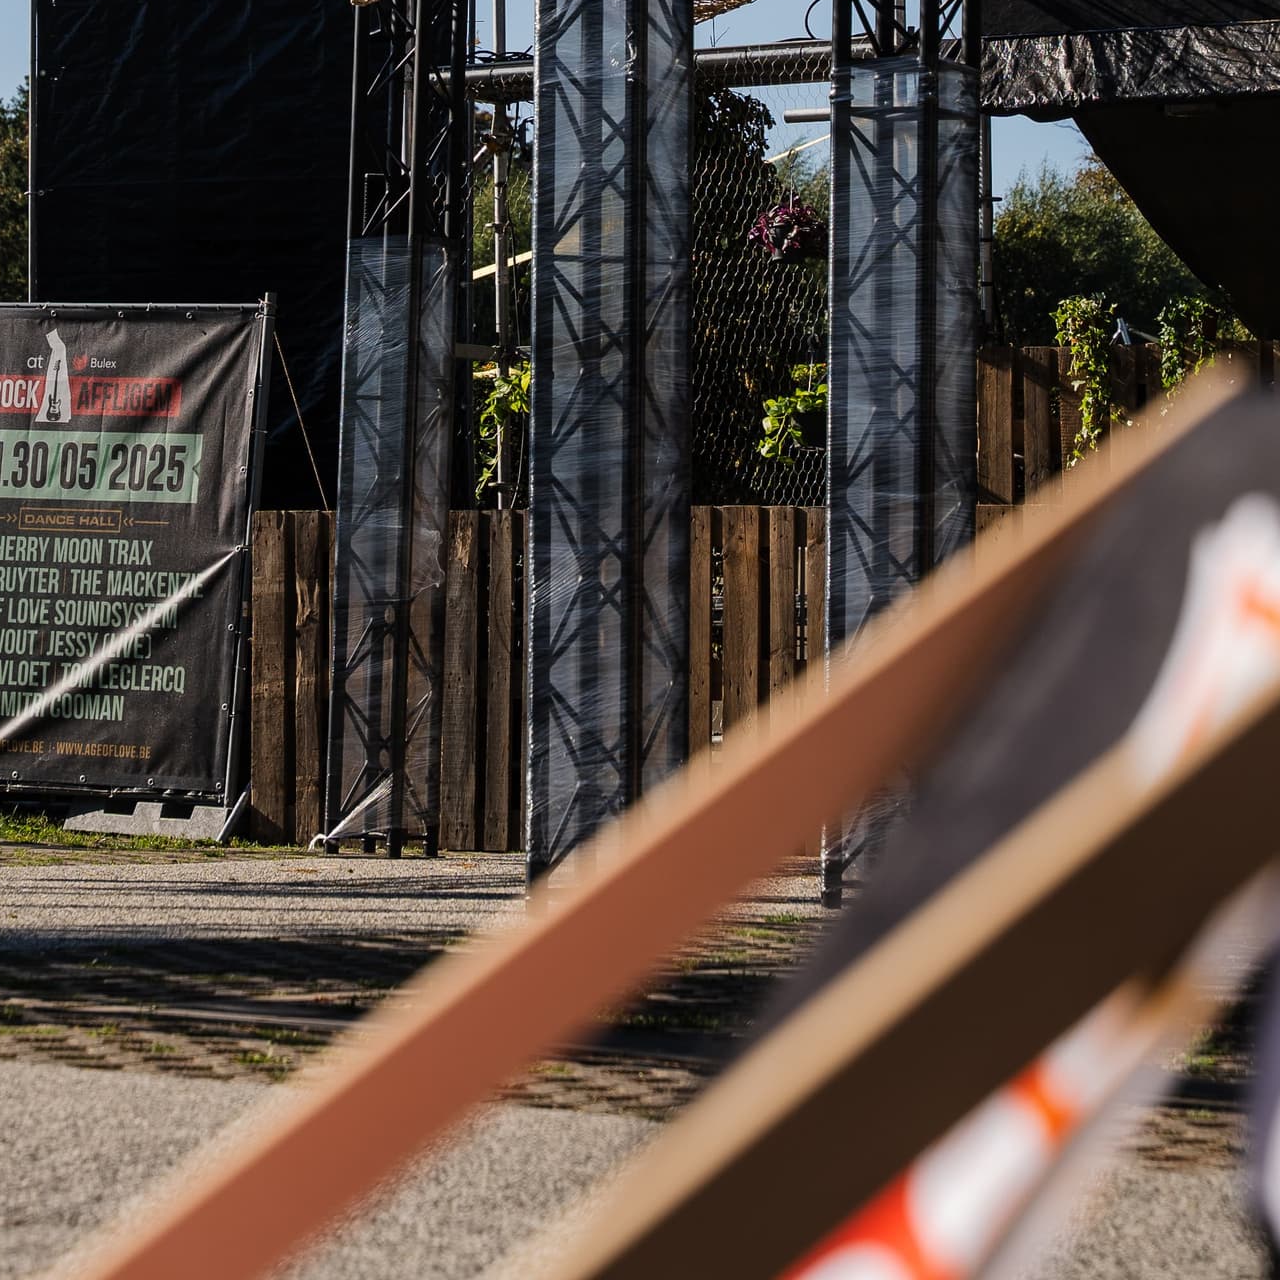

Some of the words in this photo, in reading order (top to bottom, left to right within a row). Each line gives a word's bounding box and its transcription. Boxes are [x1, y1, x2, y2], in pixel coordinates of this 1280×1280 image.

[26, 354, 44, 369] at
[90, 357, 117, 369] Bulex
[76, 382, 173, 412] AFFLIGEM
[24, 514, 75, 526] DANCE
[79, 516, 116, 527] HALL
[52, 537, 104, 565] MOON
[108, 539, 154, 566] TRAX
[70, 568, 103, 596] THE
[8, 597, 50, 625] LOVE
[46, 631, 99, 658] JESSY
[60, 662, 94, 689] TOM
[99, 663, 186, 694] LECLERCQ
[49, 693, 125, 721] COOMAN
[56, 741, 152, 759] WWW.AGEOFLOVE.BE
